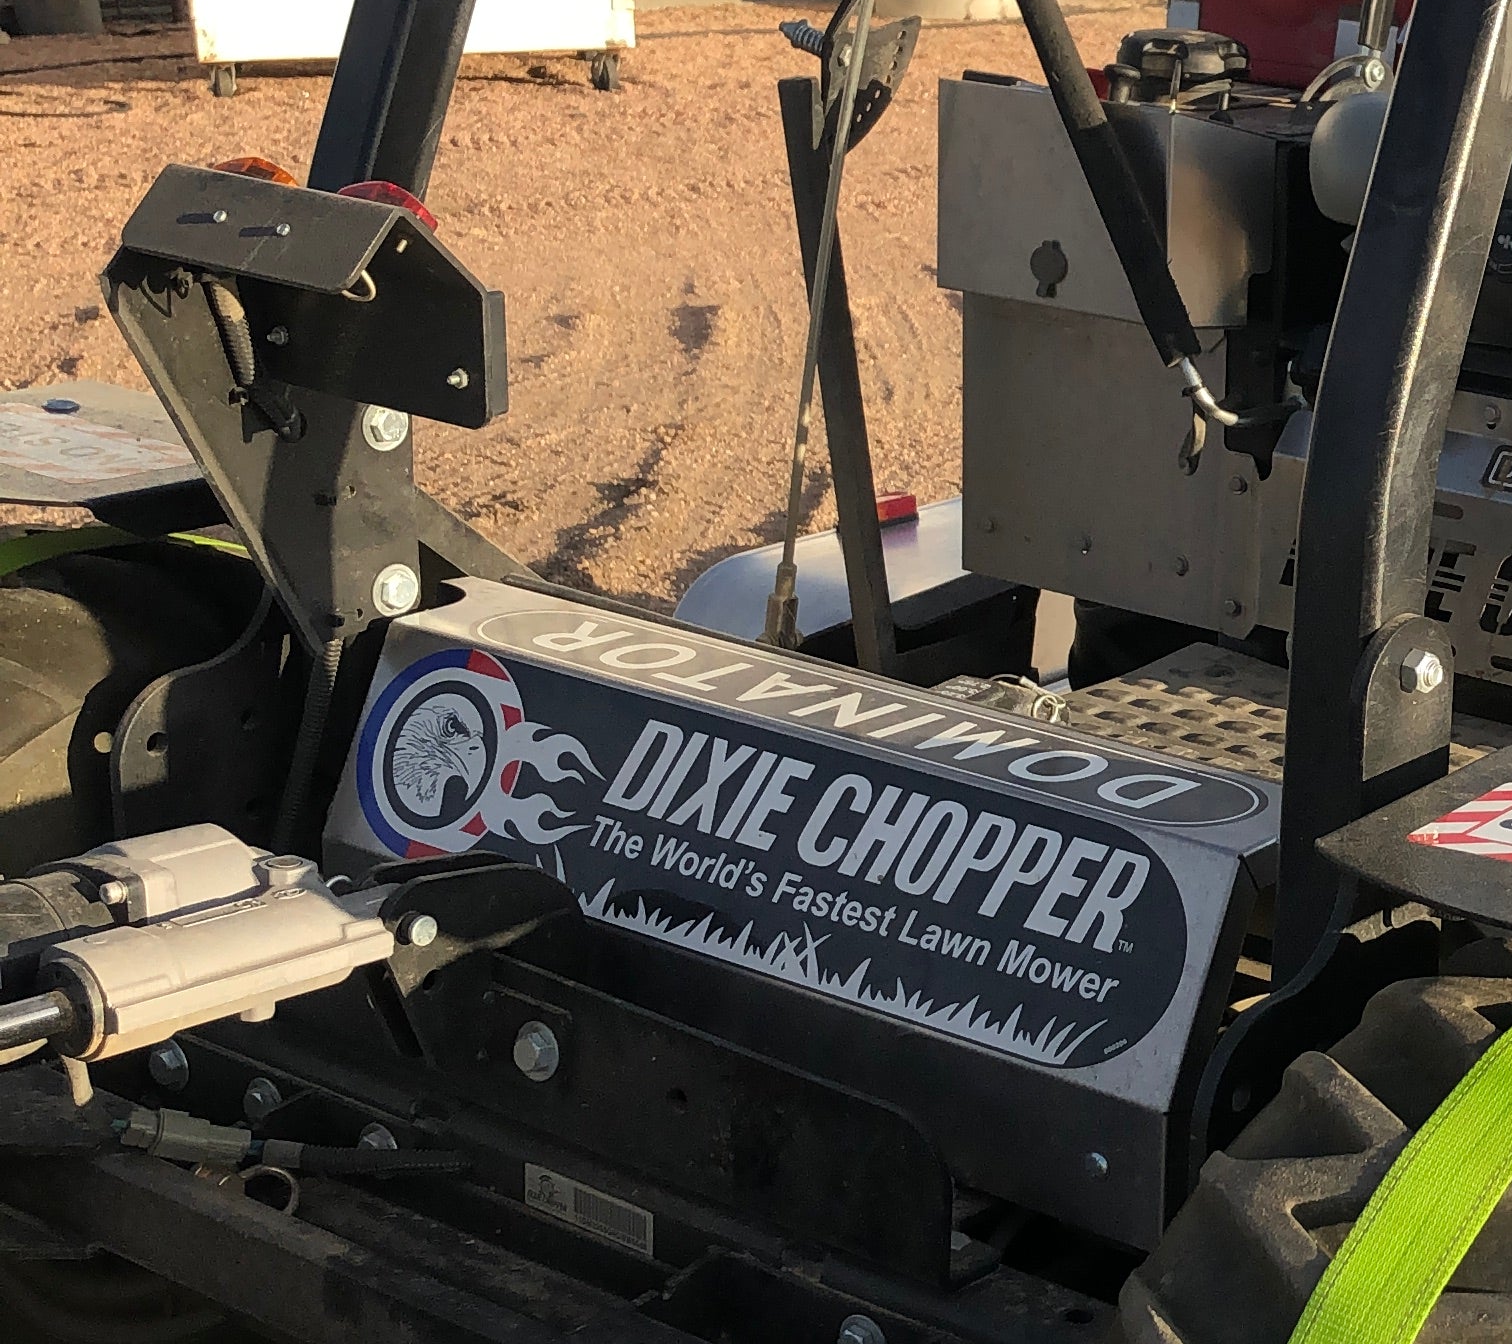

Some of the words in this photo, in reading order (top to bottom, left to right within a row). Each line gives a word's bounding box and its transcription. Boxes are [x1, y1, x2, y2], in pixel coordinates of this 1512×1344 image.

[531, 620, 1203, 809] DOMINATOR
[589, 814, 643, 860] The
[650, 833, 769, 899] World's
[772, 872, 897, 937] Fastest
[898, 908, 992, 967] Lawn
[996, 939, 1121, 1004] Mower
[602, 718, 816, 852] DIXIE
[797, 773, 1151, 954] CHOPPER
